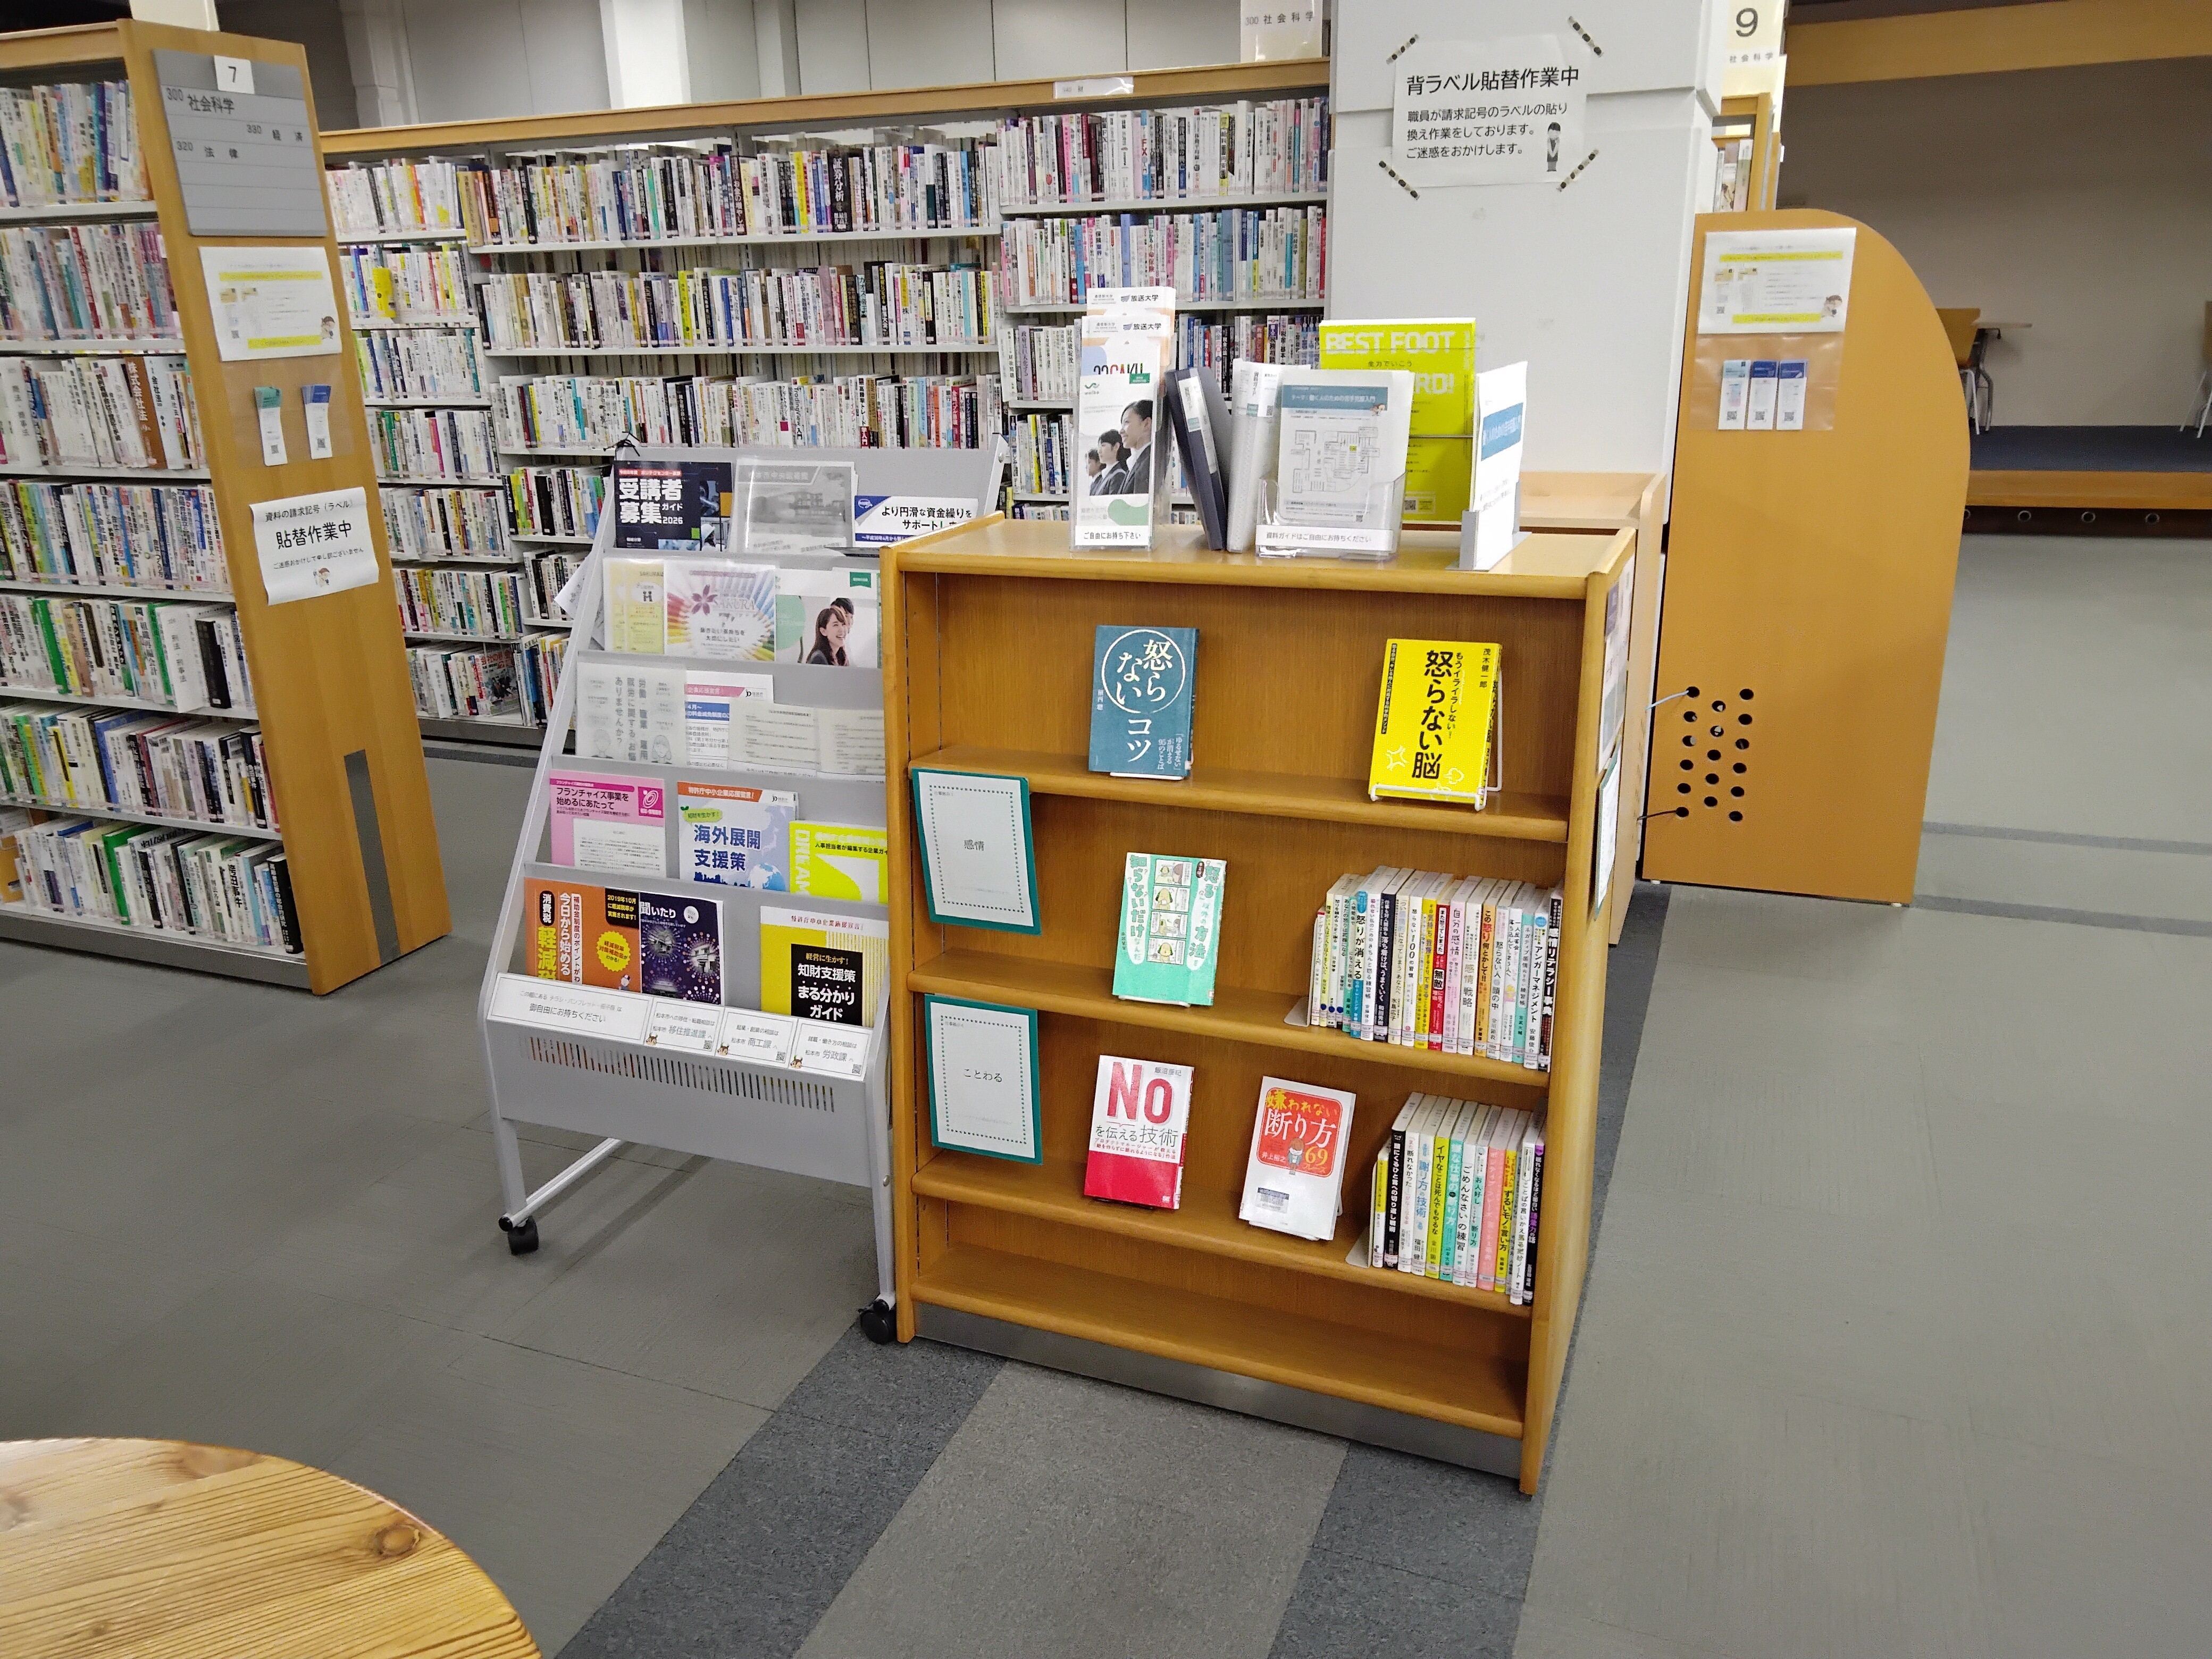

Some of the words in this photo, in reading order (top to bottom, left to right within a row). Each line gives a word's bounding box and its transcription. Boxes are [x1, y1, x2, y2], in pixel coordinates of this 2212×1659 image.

[1736, 8, 1758, 37] 9
[228, 66, 237, 83] 7
[1407, 66, 1579, 96] 背ラベル貼替作業中
[166, 87, 183, 101] 300
[187, 94, 234, 114] 社会科学
[1407, 102, 1568, 122] 職員が請求記号のラベルの貼り
[246, 124, 262, 134] 330
[1407, 124, 1534, 141] 換え作業をしております。
[1406, 143, 1523, 159] ご迷惑をおかけします。
[832, 157, 845, 202] 証券分析
[1326, 332, 1384, 355] BEST
[1390, 331, 1455, 354] FOOT
[619, 478, 683, 501] 受講者
[620, 501, 662, 524] 募集
[662, 503, 683, 512] ガイド
[882, 506, 972, 518] より円滑な資金繰りを
[276, 520, 351, 550] 貼替作業中
[1084, 532, 1141, 540] ご自由にお持ち下さい
[1266, 532, 1372, 543] 資料ガイドはご自由にお持ちください
[1117, 652, 1143, 705] ない
[1143, 639, 1172, 702] 怒ら
[1479, 648, 1491, 688] 茂木健一郎
[1412, 650, 1454, 780] 怒らない脳
[1127, 718, 1152, 762] コツ
[557, 787, 629, 802] フランチャイズ事業を
[557, 797, 614, 810] 始めるにあたって
[694, 824, 761, 850] 海外展開
[964, 839, 985, 851] 感情
[694, 849, 745, 871] 支援策
[542, 893, 552, 924] 消費税
[607, 894, 636, 904] 2019年10月
[640, 901, 676, 918] 聞いたり
[560, 892, 571, 976] 今日から始める
[1354, 915, 1365, 979] 怒りが消える
[798, 963, 856, 983] 知財支援策
[1434, 970, 1443, 988] 無敵
[798, 985, 855, 1005] まる分かり
[1462, 963, 1474, 1007] 感情戦略
[1531, 946, 1543, 1023] アンガーマネジメント
[1492, 986, 1500, 1010] 頭の中
[529, 1003, 606, 1023] 御自由にお持ちください
[810, 1005, 843, 1021] ガイド
[668, 1025, 706, 1040] 移住推進課
[747, 1037, 772, 1050] 商工課
[823, 1049, 847, 1062] 労政課
[963, 1068, 1002, 1083] ことわる
[1107, 1061, 1172, 1124] NO
[1266, 1090, 1338, 1116] 嫌われない
[1096, 1125, 1178, 1147] を伝える技術
[1264, 1109, 1336, 1148] 断り方
[1305, 1146, 1328, 1166] 69
[1432, 1145, 1445, 1235] イヤなことは死んでもやるな
[1470, 1226, 1479, 1246] 断り方
